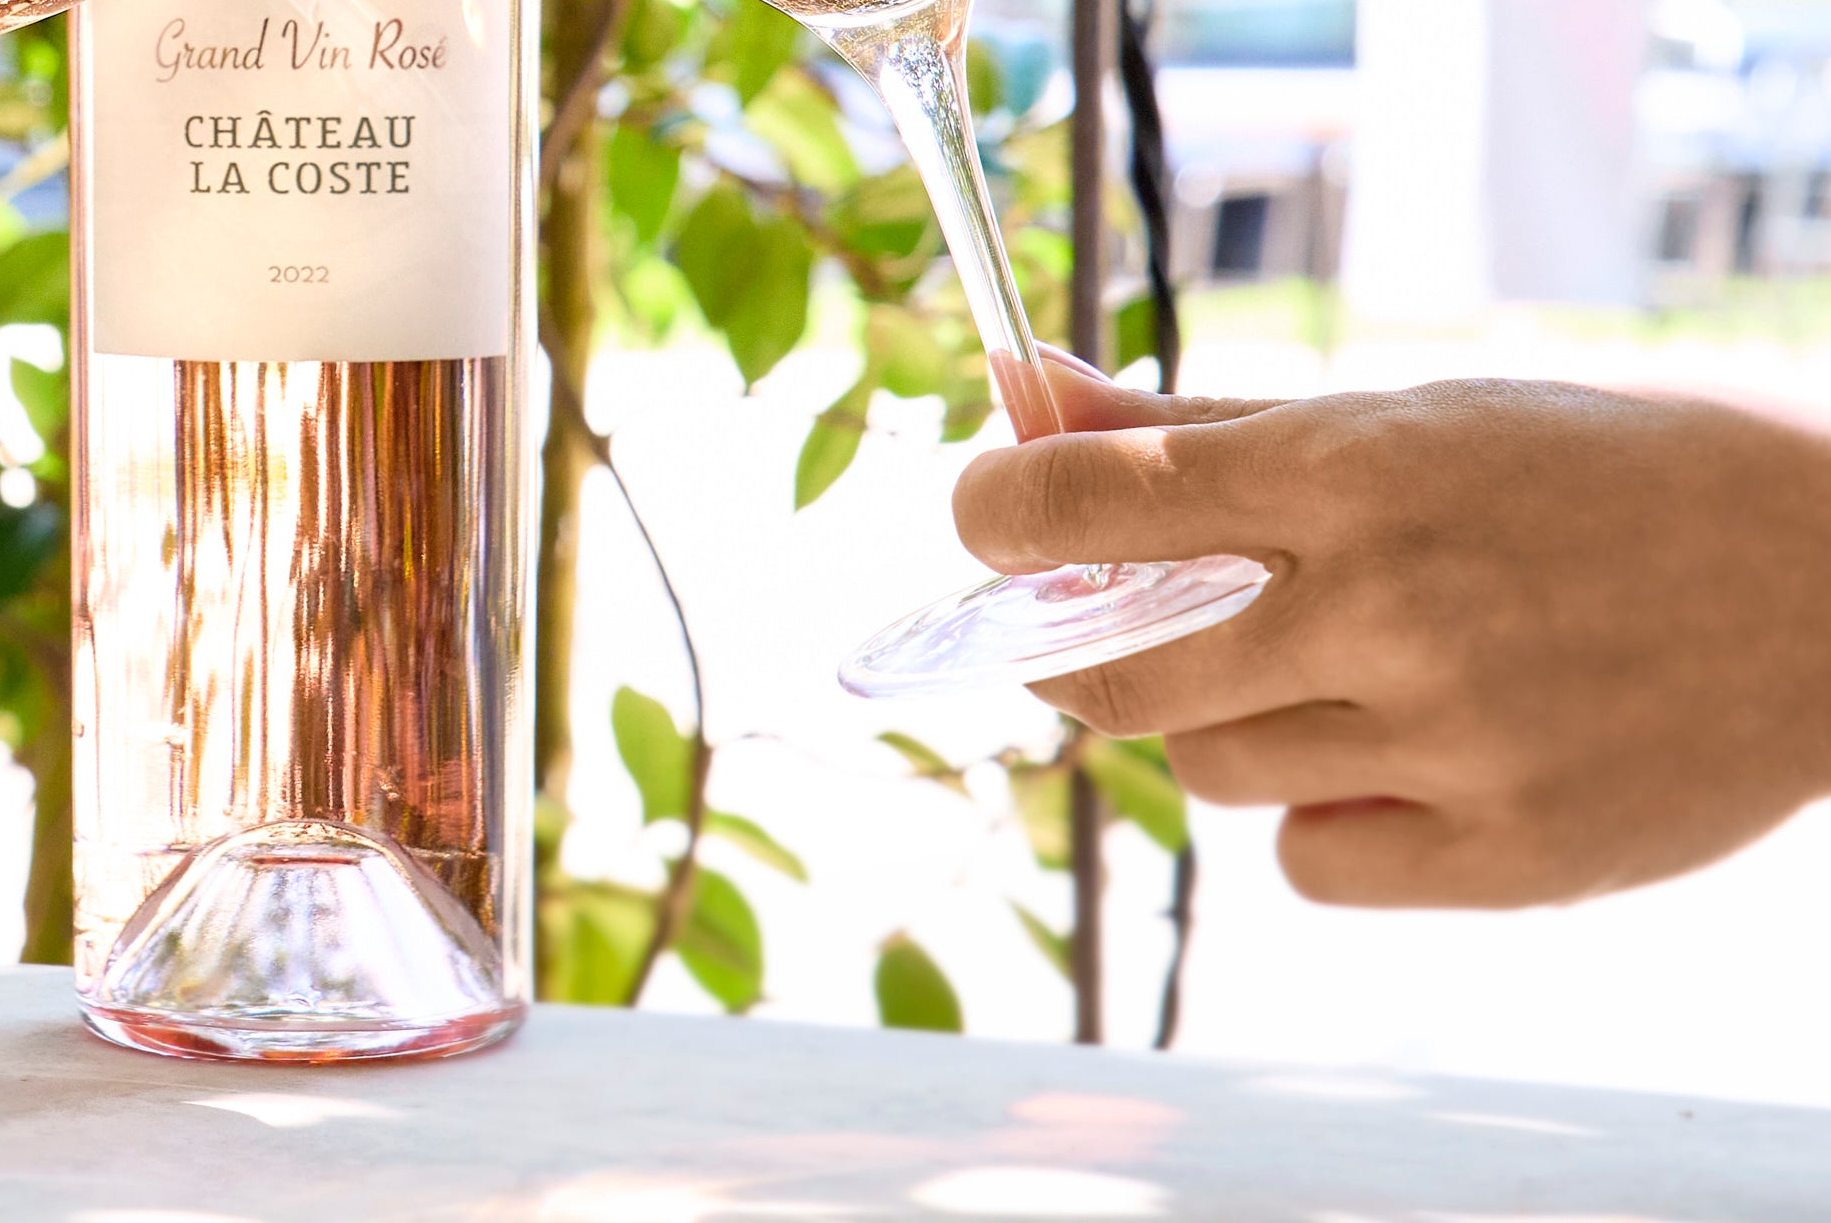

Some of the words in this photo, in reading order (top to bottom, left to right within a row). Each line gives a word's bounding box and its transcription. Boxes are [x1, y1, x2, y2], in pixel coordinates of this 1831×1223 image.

[155, 17, 270, 83] Grand
[281, 19, 352, 71] Vin
[369, 17, 449, 71] Rosé
[184, 110, 416, 149] CHÂTEAU
[190, 161, 250, 194] LA
[268, 161, 410, 195] COSTE
[268, 265, 330, 284] 2022
